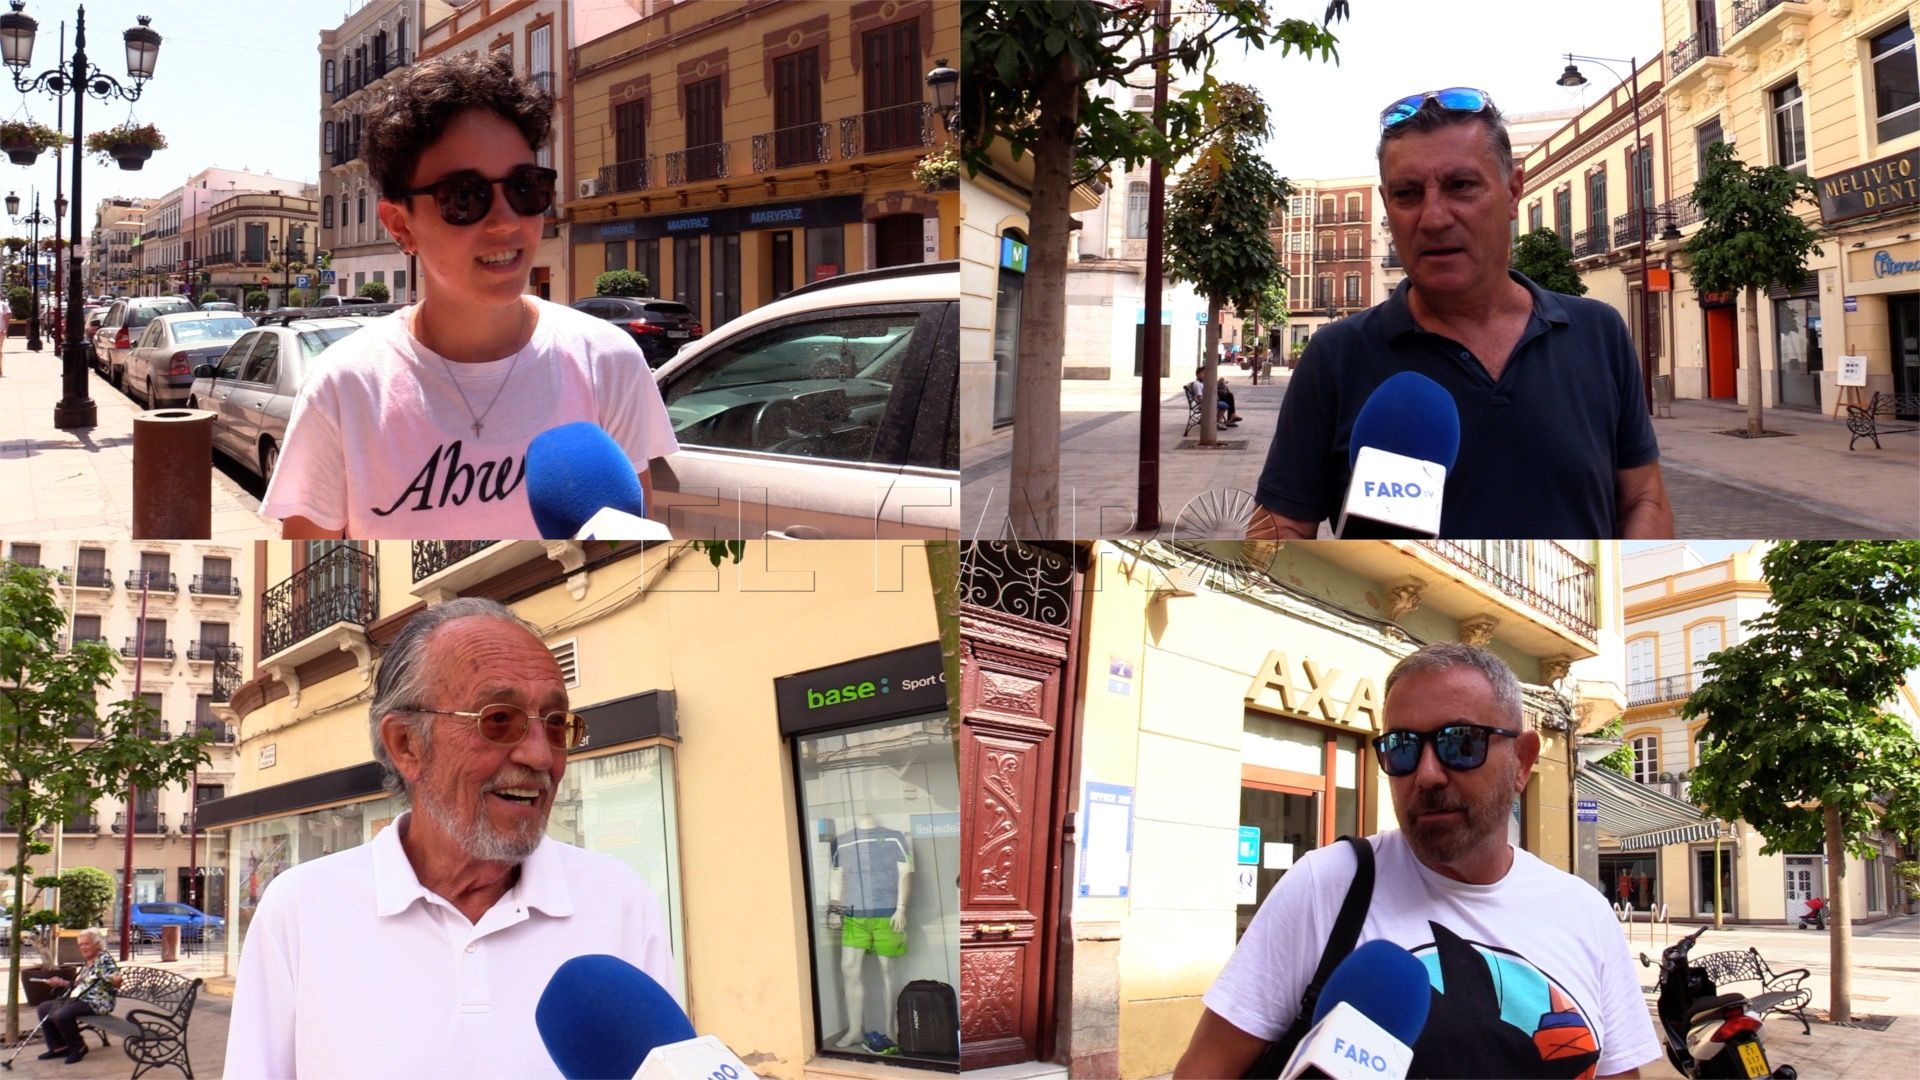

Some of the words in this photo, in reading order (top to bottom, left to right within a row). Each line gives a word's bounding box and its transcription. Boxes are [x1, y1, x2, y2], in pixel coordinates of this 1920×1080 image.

[1824, 159, 1911, 199] MELIVEO
[1863, 179, 1916, 208] DENT
[667, 217, 709, 230] MARYPAZ
[751, 208, 803, 223] MARYPAZ
[601, 225, 635, 236] MARYPAZ
[298, 278, 307, 288] P
[1364, 481, 1421, 498] FARO
[902, 675, 936, 691] Sport
[1244, 649, 1384, 731] AXA
[196, 867, 225, 877] ARA
[1334, 1038, 1387, 1072] FARO
